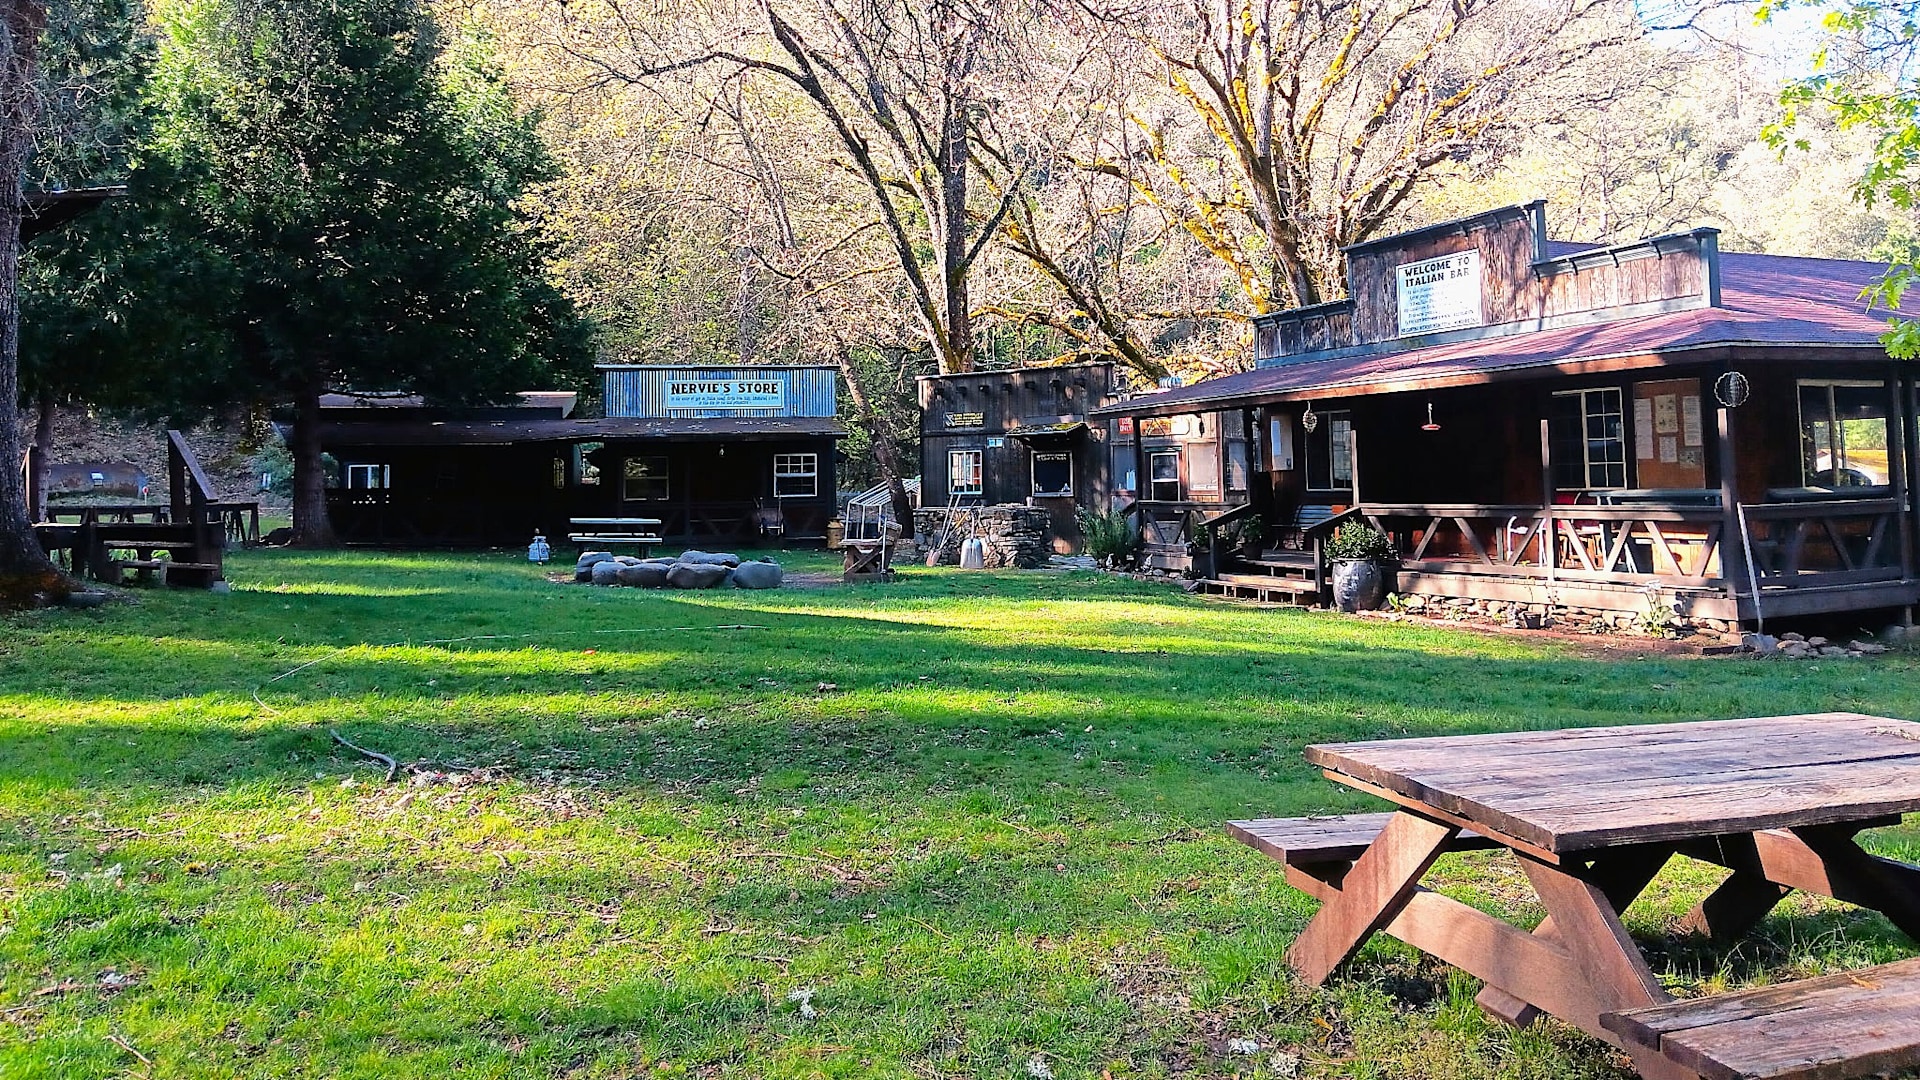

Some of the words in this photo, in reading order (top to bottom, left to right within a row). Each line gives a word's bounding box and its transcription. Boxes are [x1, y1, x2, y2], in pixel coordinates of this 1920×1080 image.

[1404, 261, 1451, 277] WELCOME
[1458, 256, 1470, 266] TO
[1405, 273, 1445, 287] ITALIAN
[1450, 267, 1470, 279] BAR
[671, 383, 731, 395] NERVIE'S
[738, 383, 778, 394] STORE
